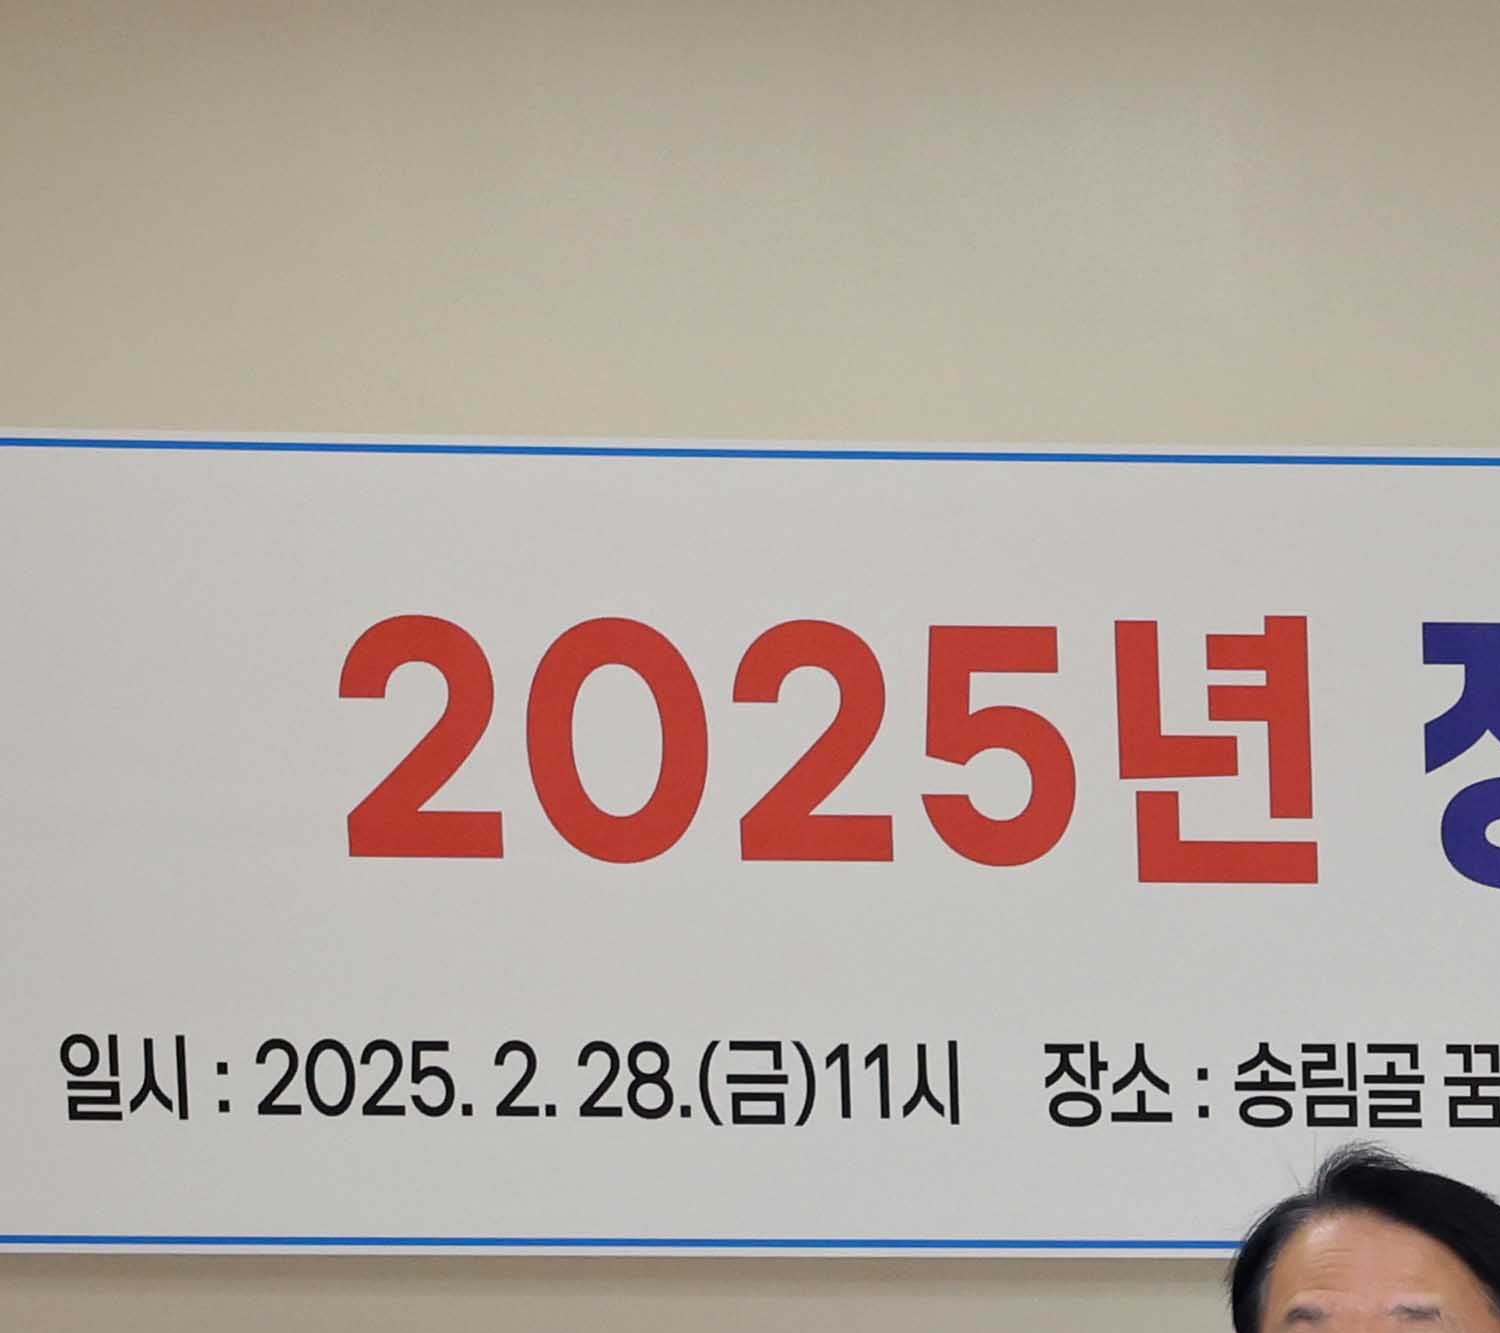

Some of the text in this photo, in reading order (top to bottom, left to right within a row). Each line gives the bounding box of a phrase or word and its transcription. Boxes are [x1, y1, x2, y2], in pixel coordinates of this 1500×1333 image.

[338, 613, 1320, 886] 2025년
[58, 1033, 190, 1122] 일시
[255, 1038, 473, 1119] 2025.
[494, 1039, 557, 1118] 2.
[576, 1039, 961, 1127] 28.(금)11시
[1043, 1040, 1174, 1129] 장소
[1234, 1041, 1426, 1129] 송림골
